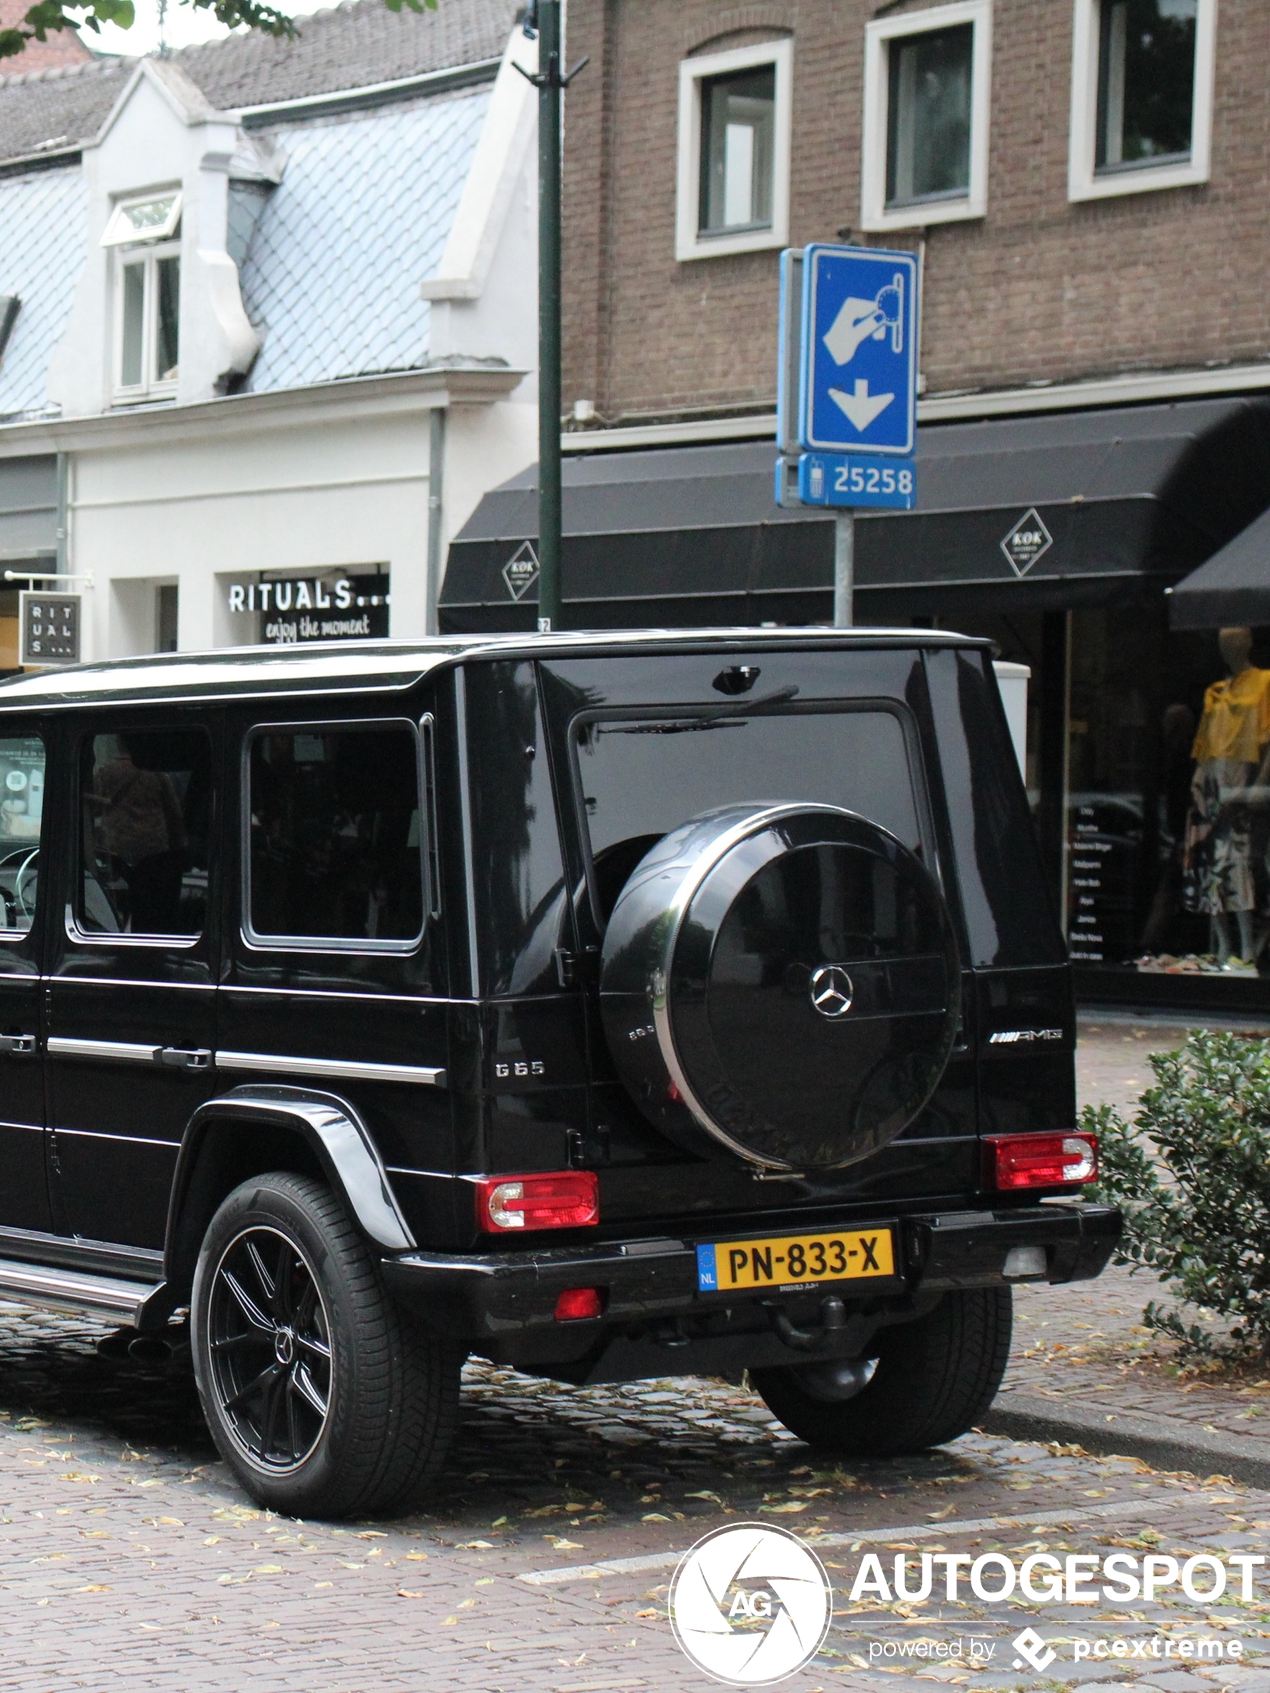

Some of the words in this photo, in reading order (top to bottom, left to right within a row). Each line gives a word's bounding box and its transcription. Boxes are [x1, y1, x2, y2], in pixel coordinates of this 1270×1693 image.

[834, 466, 913, 494] 25258
[1011, 530, 1043, 546] KOK
[266, 617, 297, 644] enjoy
[299, 615, 319, 638] the
[321, 614, 370, 635] moment
[514, 1061, 545, 1076] 65
[729, 1236, 880, 1283] PN-833-X
[701, 1272, 715, 1284] NL
